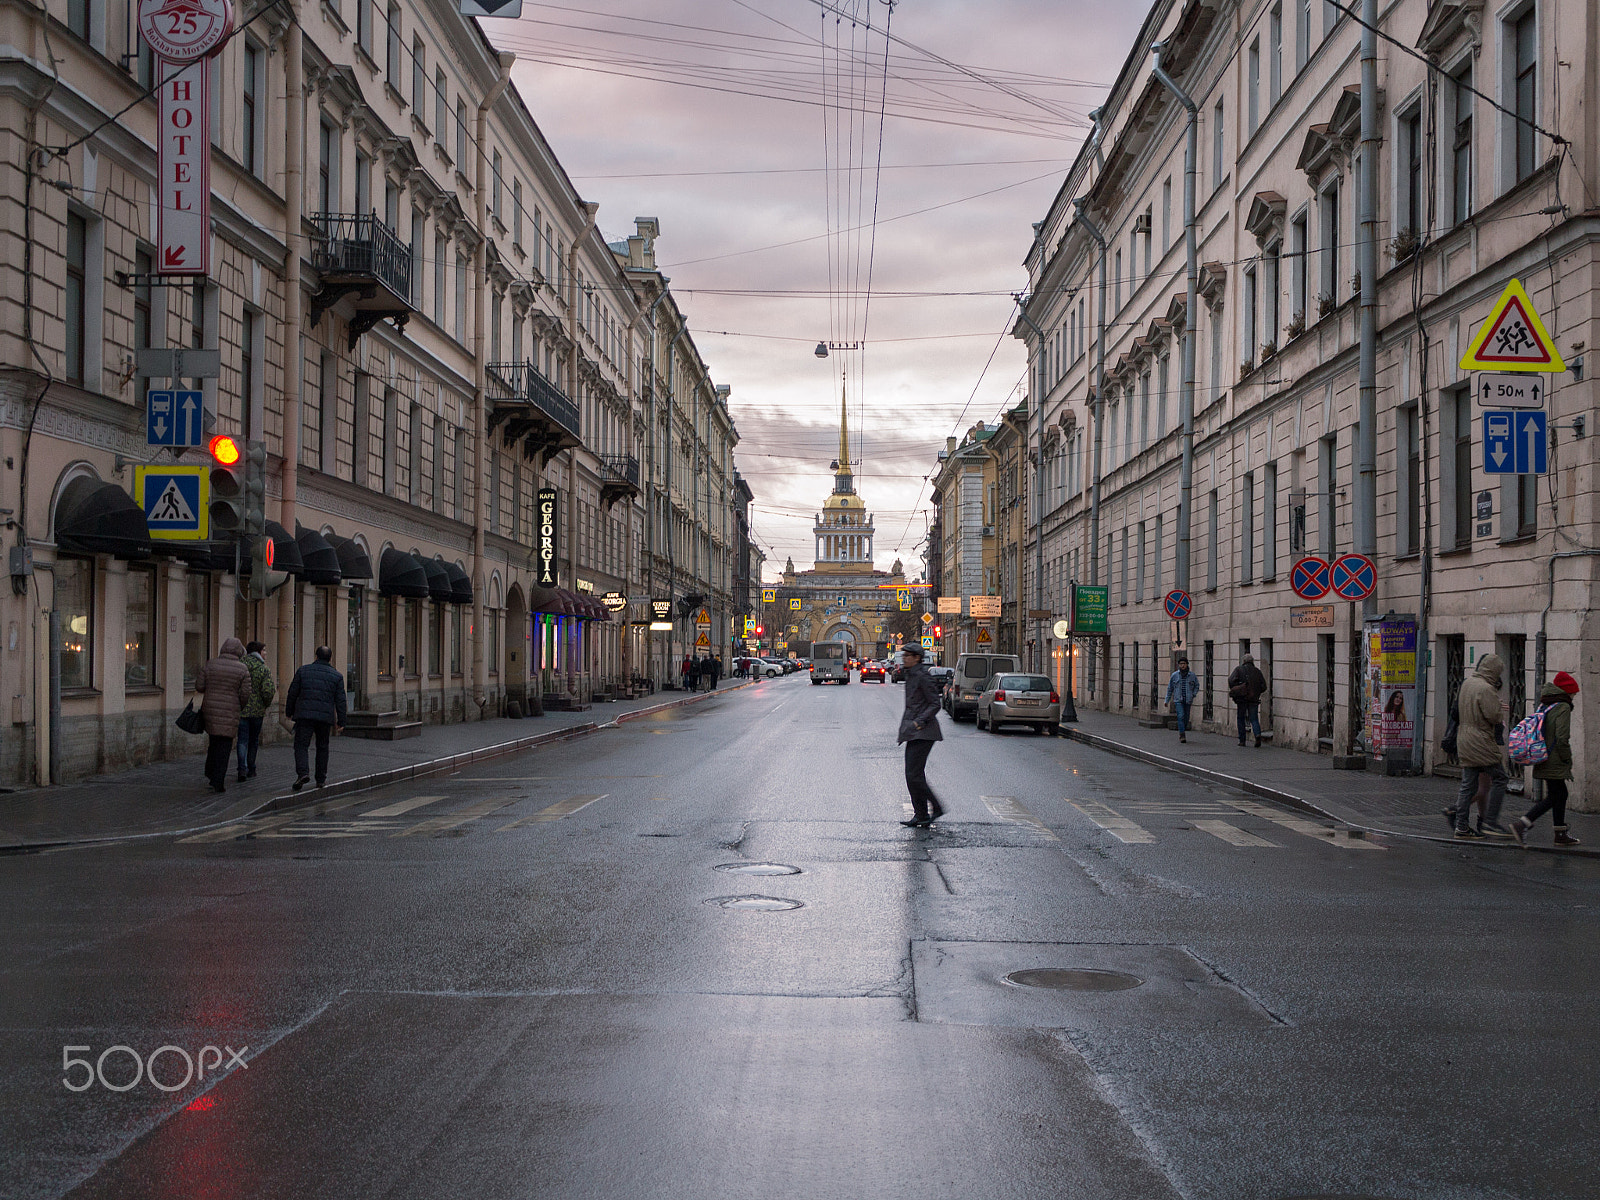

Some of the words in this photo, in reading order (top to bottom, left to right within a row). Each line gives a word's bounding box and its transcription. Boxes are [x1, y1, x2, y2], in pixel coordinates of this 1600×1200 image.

[146, 27, 180, 56] Bolshaya
[182, 27, 220, 56] Morskaya
[167, 11, 198, 35] 25
[171, 80, 193, 211] HOTEL
[541, 501, 554, 583] GEORGIA
